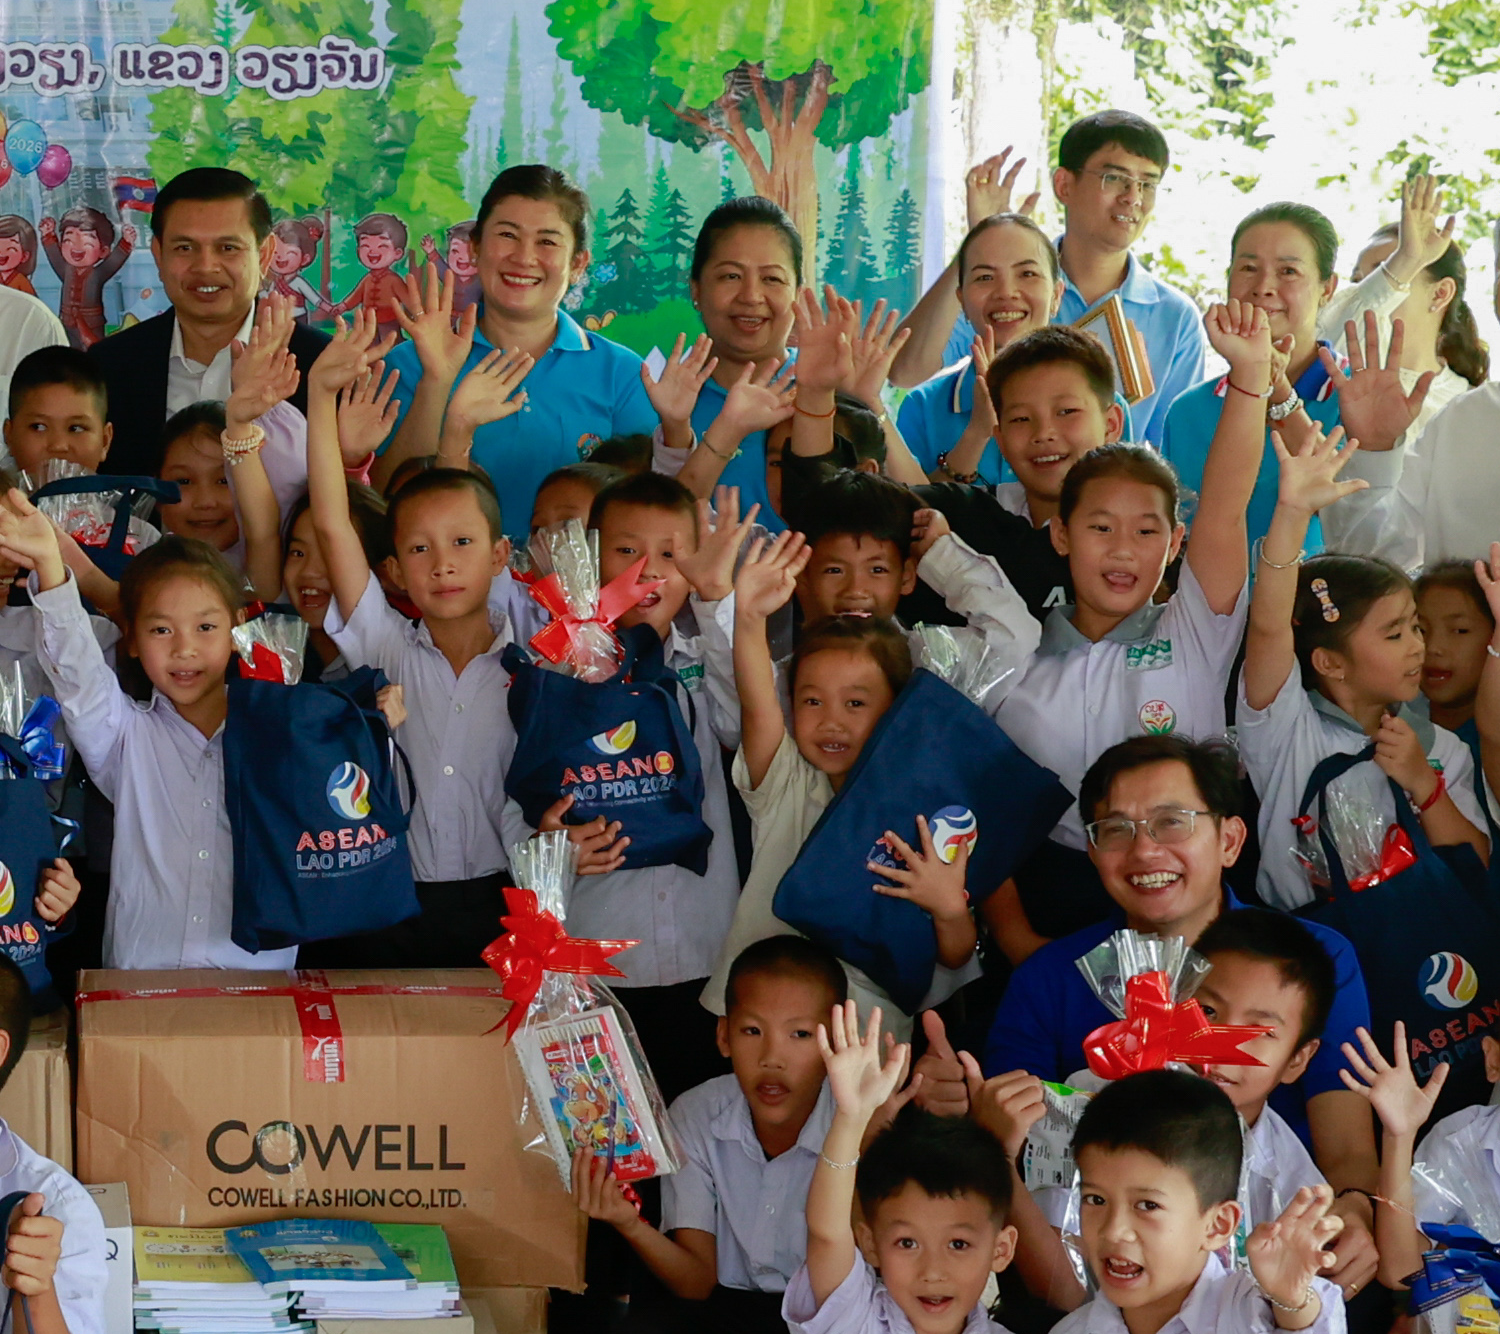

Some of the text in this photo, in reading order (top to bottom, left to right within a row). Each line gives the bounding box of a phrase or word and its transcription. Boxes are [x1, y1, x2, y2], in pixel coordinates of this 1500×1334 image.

[9, 138, 43, 154] 2026
[561, 754, 654, 786] ASEAN
[601, 778, 639, 799] PDR
[296, 853, 334, 871] LAO
[338, 848, 371, 869] PDR
[206, 1120, 467, 1175] COWELL
[207, 1187, 468, 1211] COWELL FASHION CO.,LTD.
